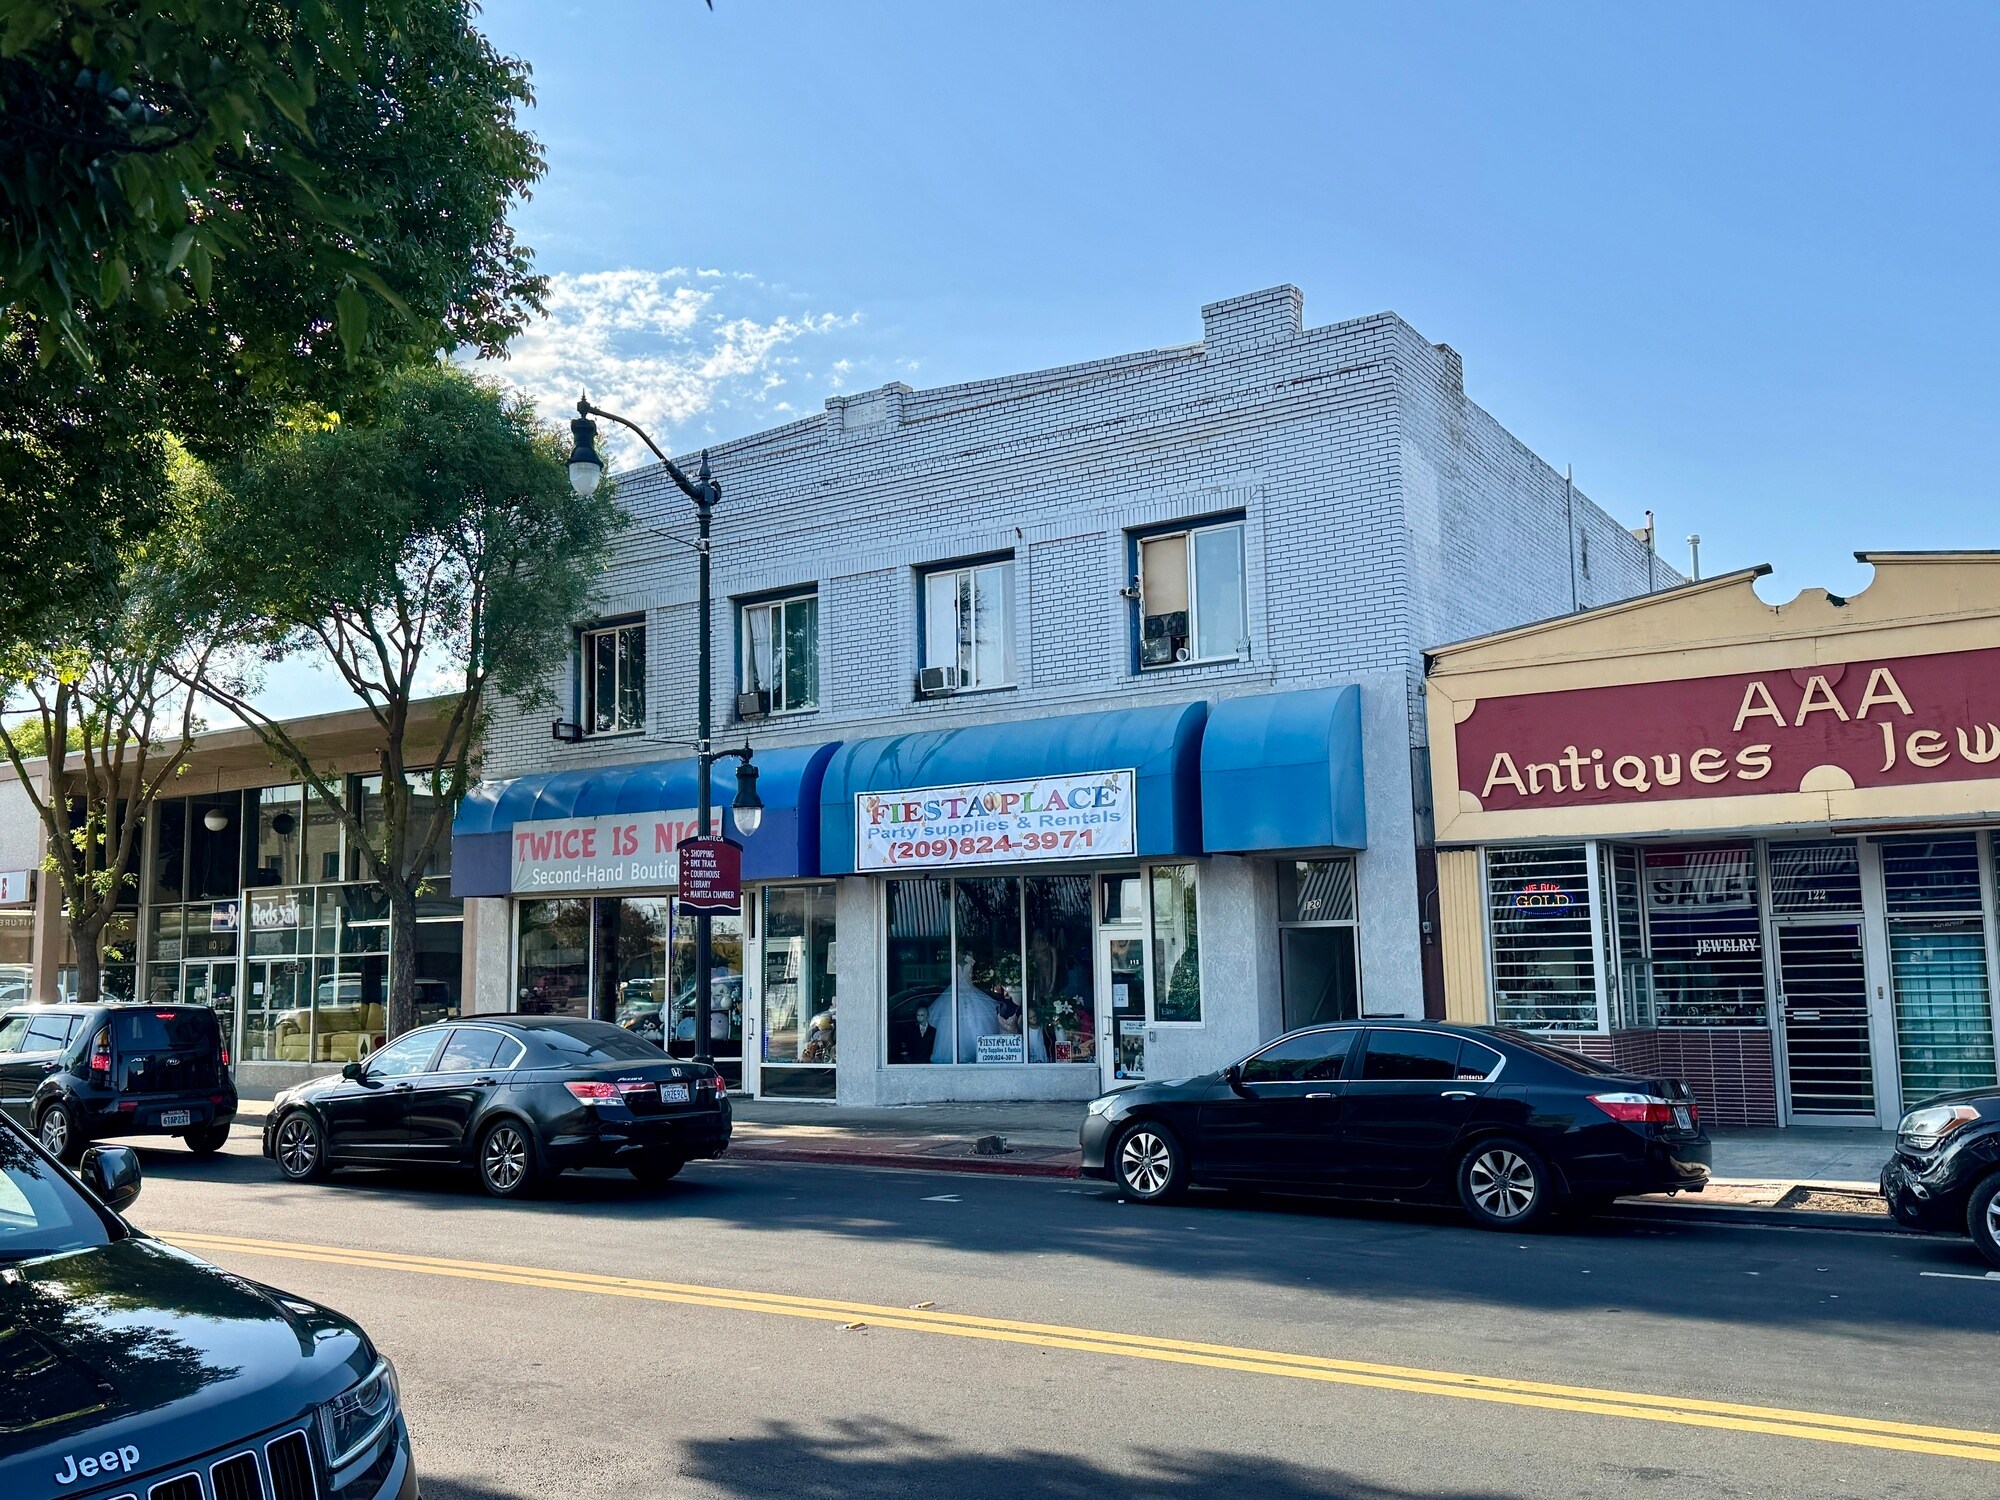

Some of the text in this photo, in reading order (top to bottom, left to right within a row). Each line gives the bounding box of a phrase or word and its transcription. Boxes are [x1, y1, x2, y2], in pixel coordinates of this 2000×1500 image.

[1732, 668, 1914, 732] AAA
[1481, 744, 1772, 798] Antiques
[870, 785, 1117, 825] FIESTA PLACE
[867, 810, 1122, 839] Party supplies & Rentals
[515, 828, 597, 862] TWICE
[612, 824, 639, 856] IS
[888, 828, 1093, 863] (209)824-3971
[690, 850, 714, 858] SHOPPING
[702, 860, 717, 868] TRACK
[532, 859, 678, 886] Second-Hand Boutiq
[690, 870, 720, 878] COURTHOUSE
[690, 890, 734, 898] MANTECA CHAMBER
[1540, 883, 1561, 893] BUY
[1807, 889, 1826, 900] 122
[1305, 900, 1320, 909] 120
[1516, 894, 1569, 907] GOLD
[1696, 938, 1757, 956] JEWELRY
[1001, 1036, 1020, 1047] PLACE
[55, 1444, 140, 1484] Jeep
